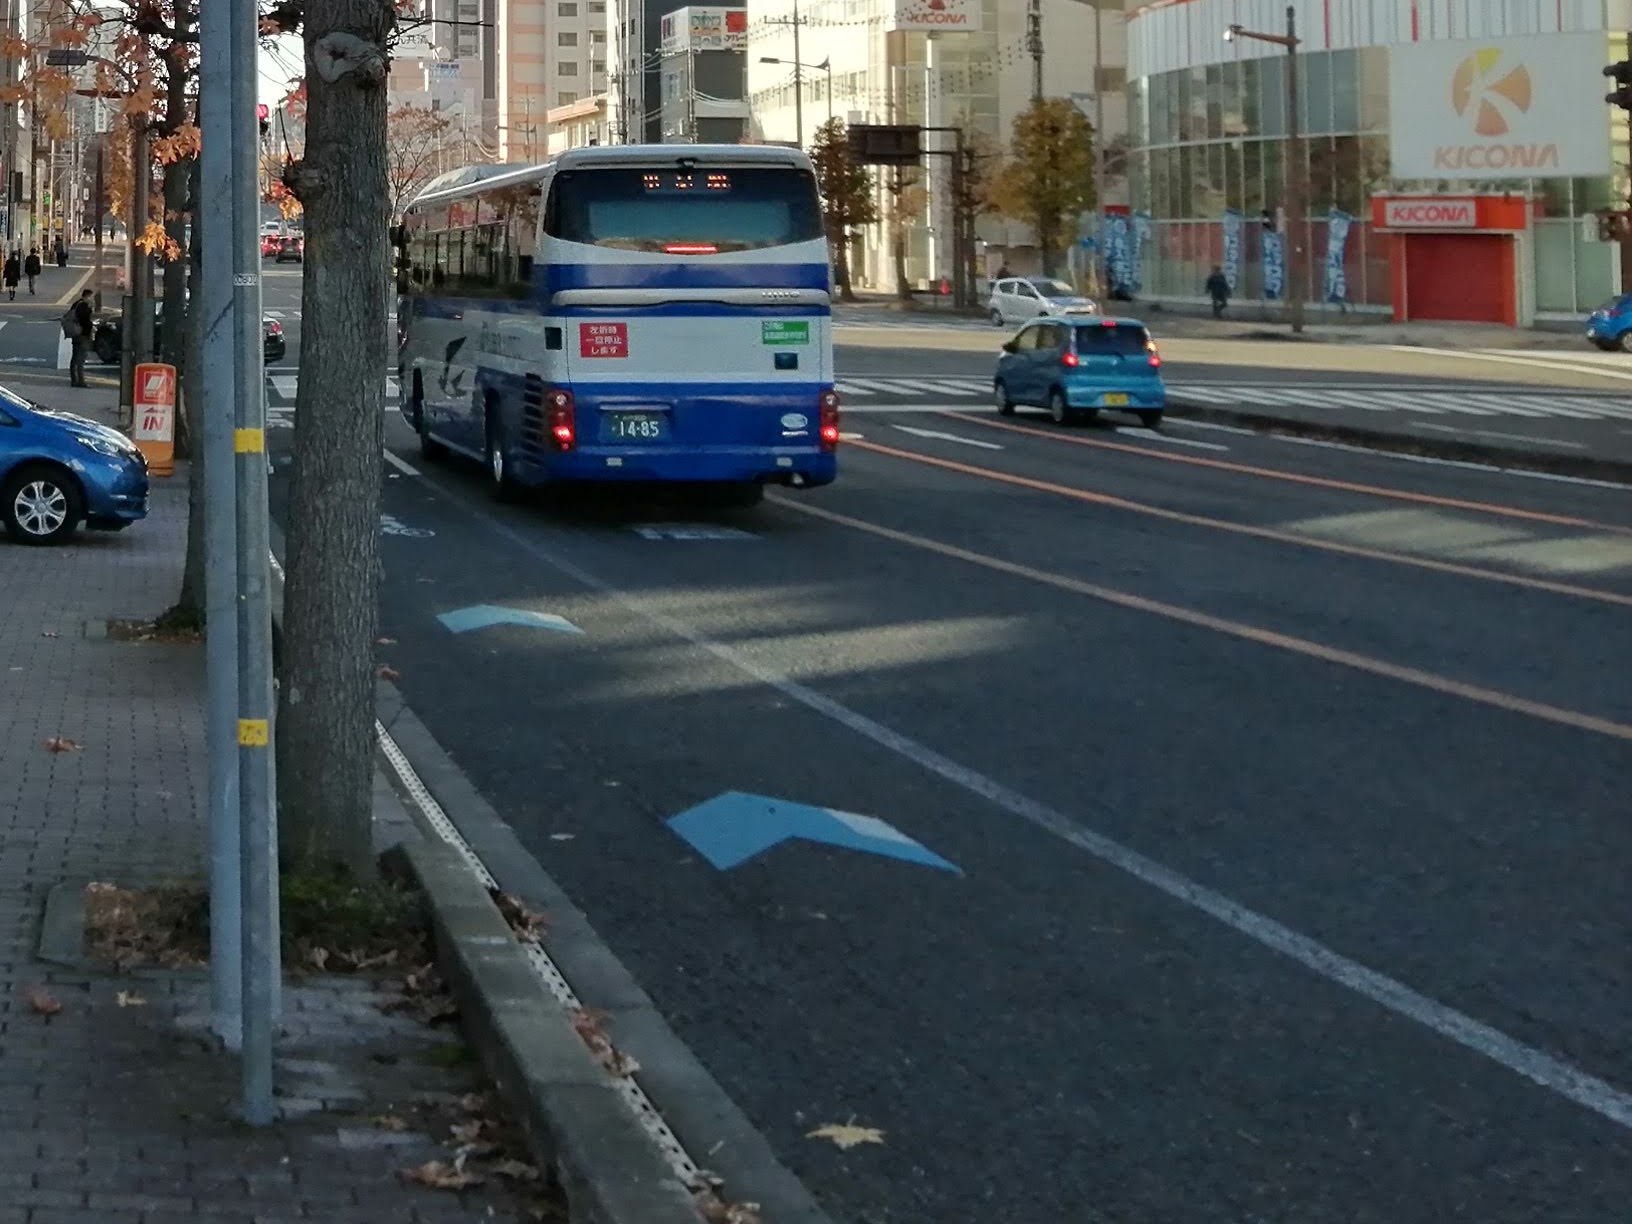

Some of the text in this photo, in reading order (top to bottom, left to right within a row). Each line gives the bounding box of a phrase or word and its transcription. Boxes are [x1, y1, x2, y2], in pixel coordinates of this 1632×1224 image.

[908, 12, 967, 25] KICONA
[1433, 143, 1560, 170] KICONA
[1392, 205, 1469, 223] KICONA
[143, 415, 165, 431] IN
